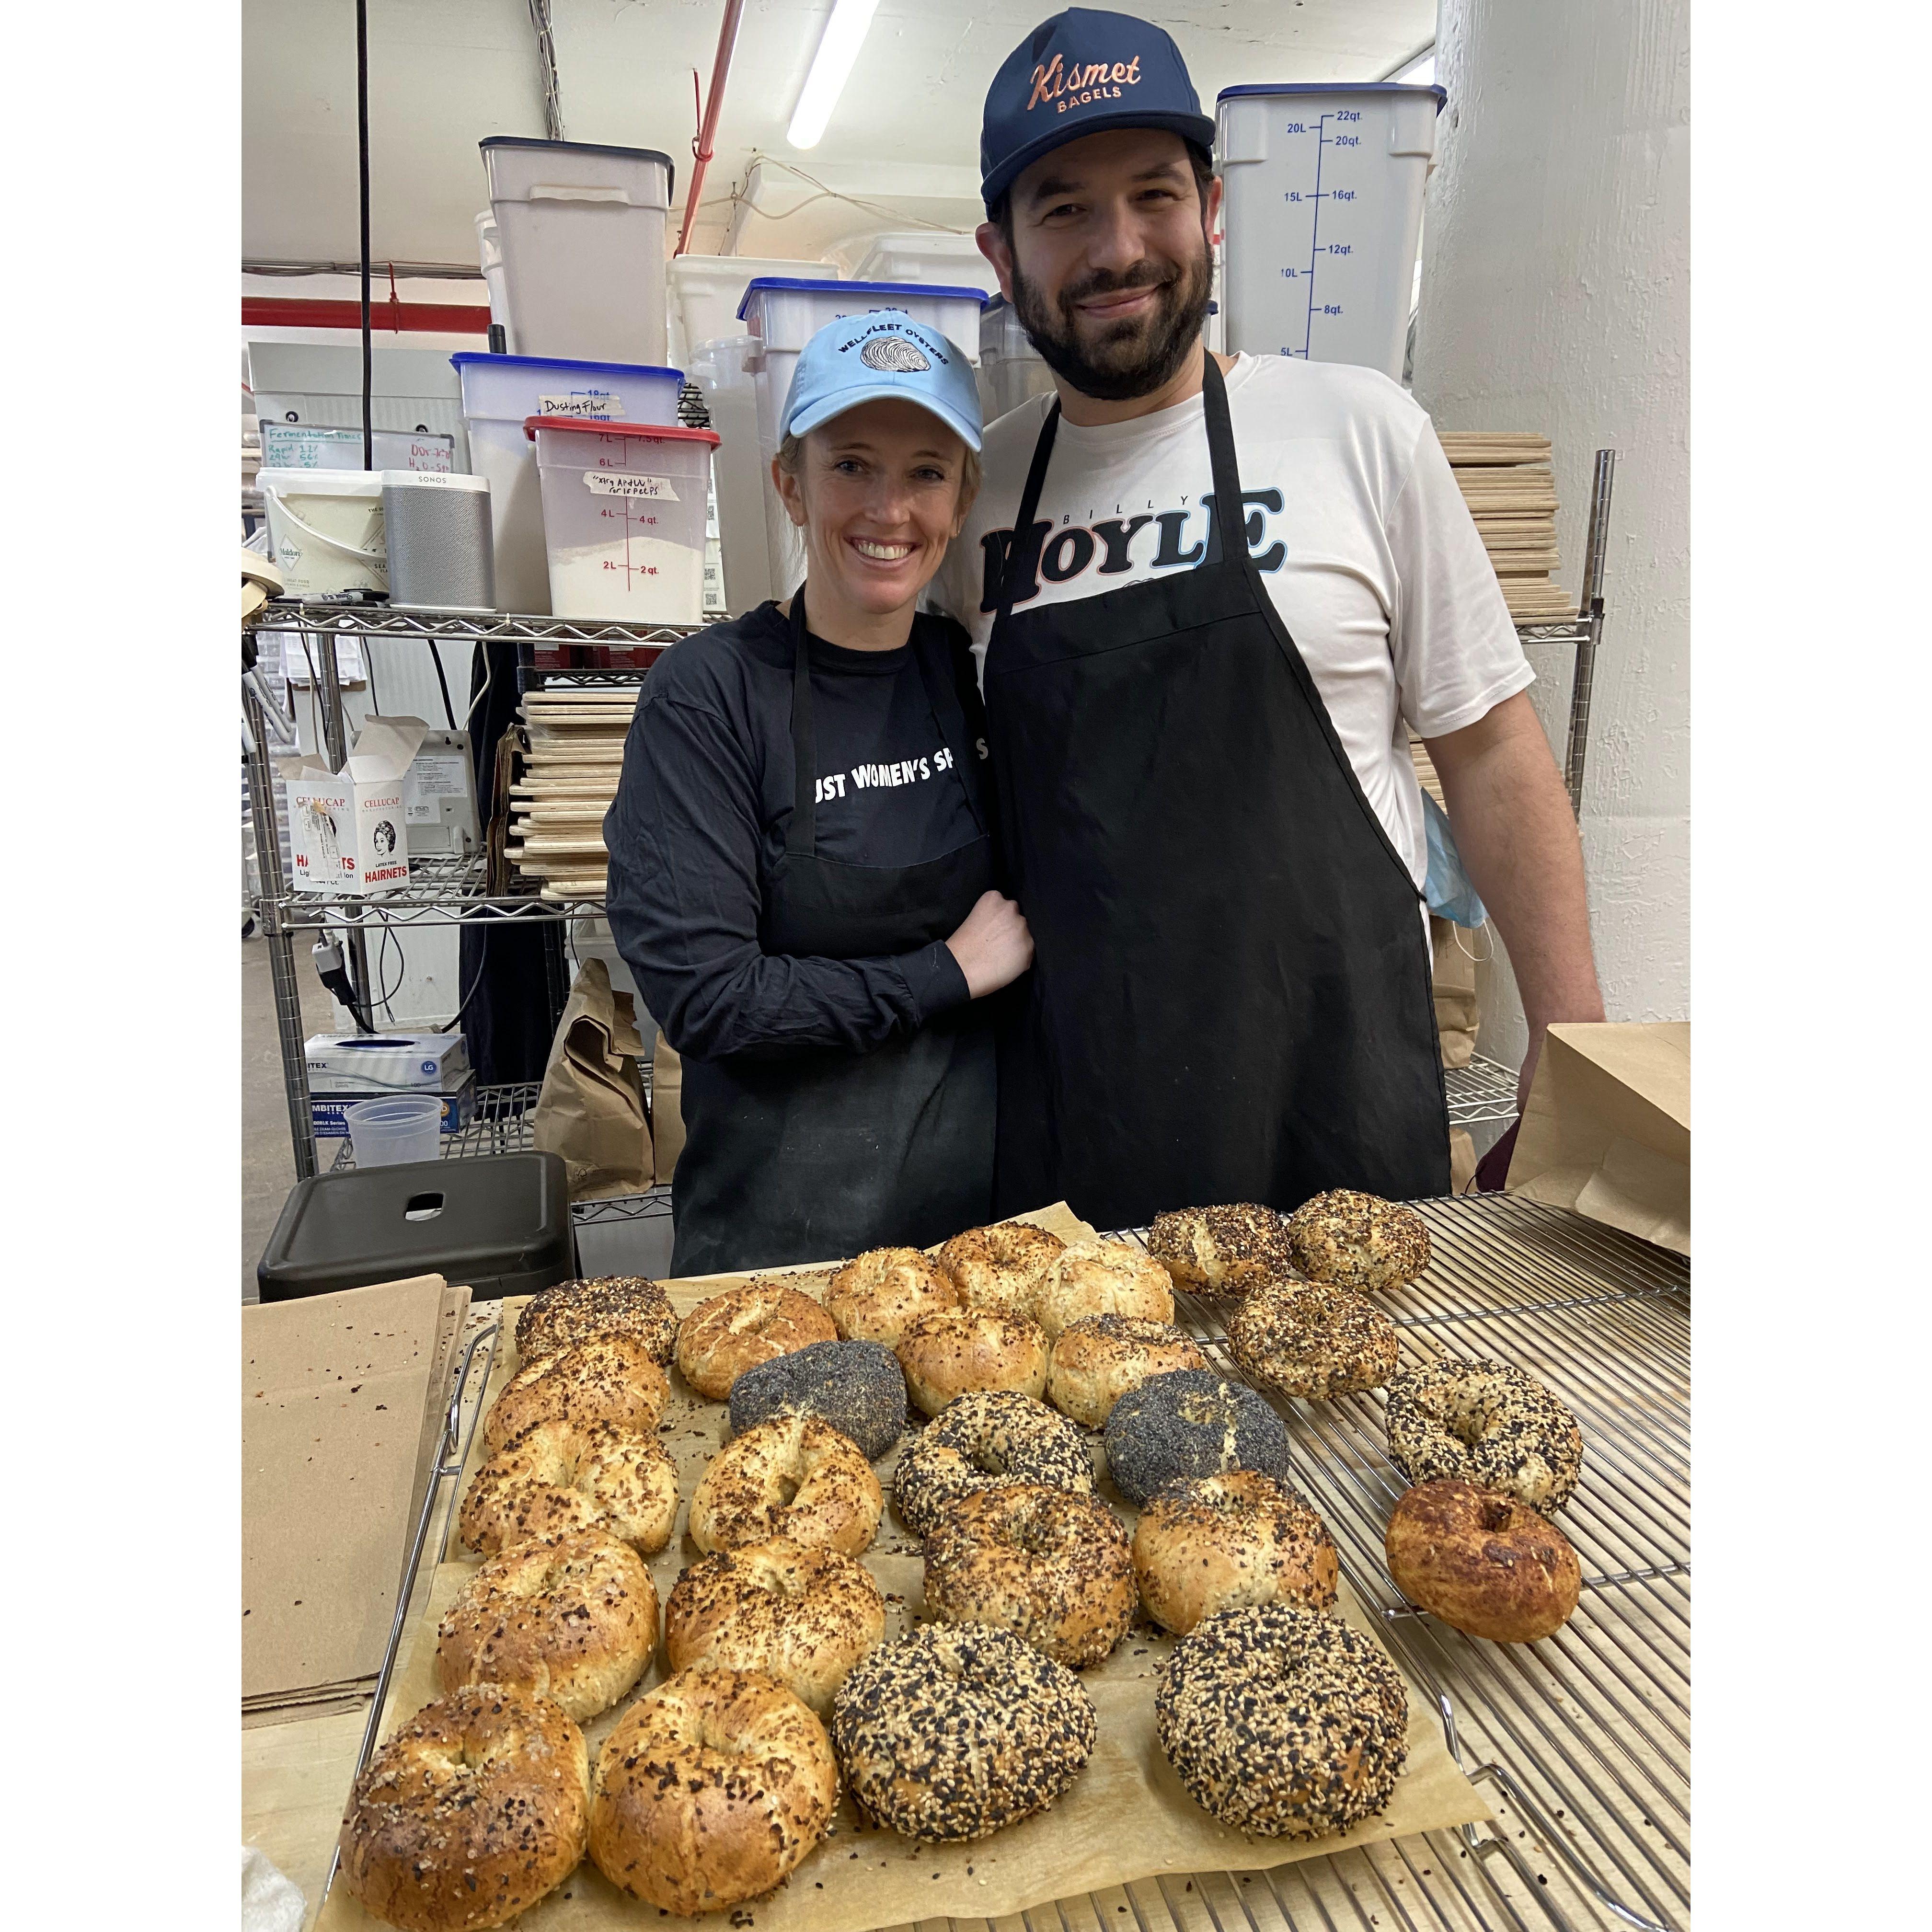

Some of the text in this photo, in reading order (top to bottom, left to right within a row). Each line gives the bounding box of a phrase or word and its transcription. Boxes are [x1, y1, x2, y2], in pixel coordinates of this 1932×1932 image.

[1027, 53, 1141, 111] Kismet
[1057, 86, 1122, 114] BAGELS
[1337, 111, 1363, 122] 22qt.
[1287, 123, 1306, 133] 20L
[1335, 136, 1361, 147] 20qt.
[1284, 192, 1302, 201] 15L
[1332, 190, 1357, 200] 16qt.
[1329, 244, 1354, 254] 12qt.
[1281, 268, 1298, 277] 10L
[1324, 305, 1344, 315] 8qt.
[839, 324, 949, 365] WELLFLEET OYSTERS
[1281, 347, 1293, 356] 5L
[545, 400, 581, 414] Dusting
[582, 400, 607, 413] Flour
[269, 428, 334, 439] Fermentation
[1062, 495, 1188, 525] BILLY
[280, 548, 300, 556] Maldon
[980, 487, 1288, 615] HOYLE
[851, 757, 931, 789] WOMEN'S
[365, 797, 399, 808] CELLUCAP
[365, 866, 407, 884] HAIRNETS
